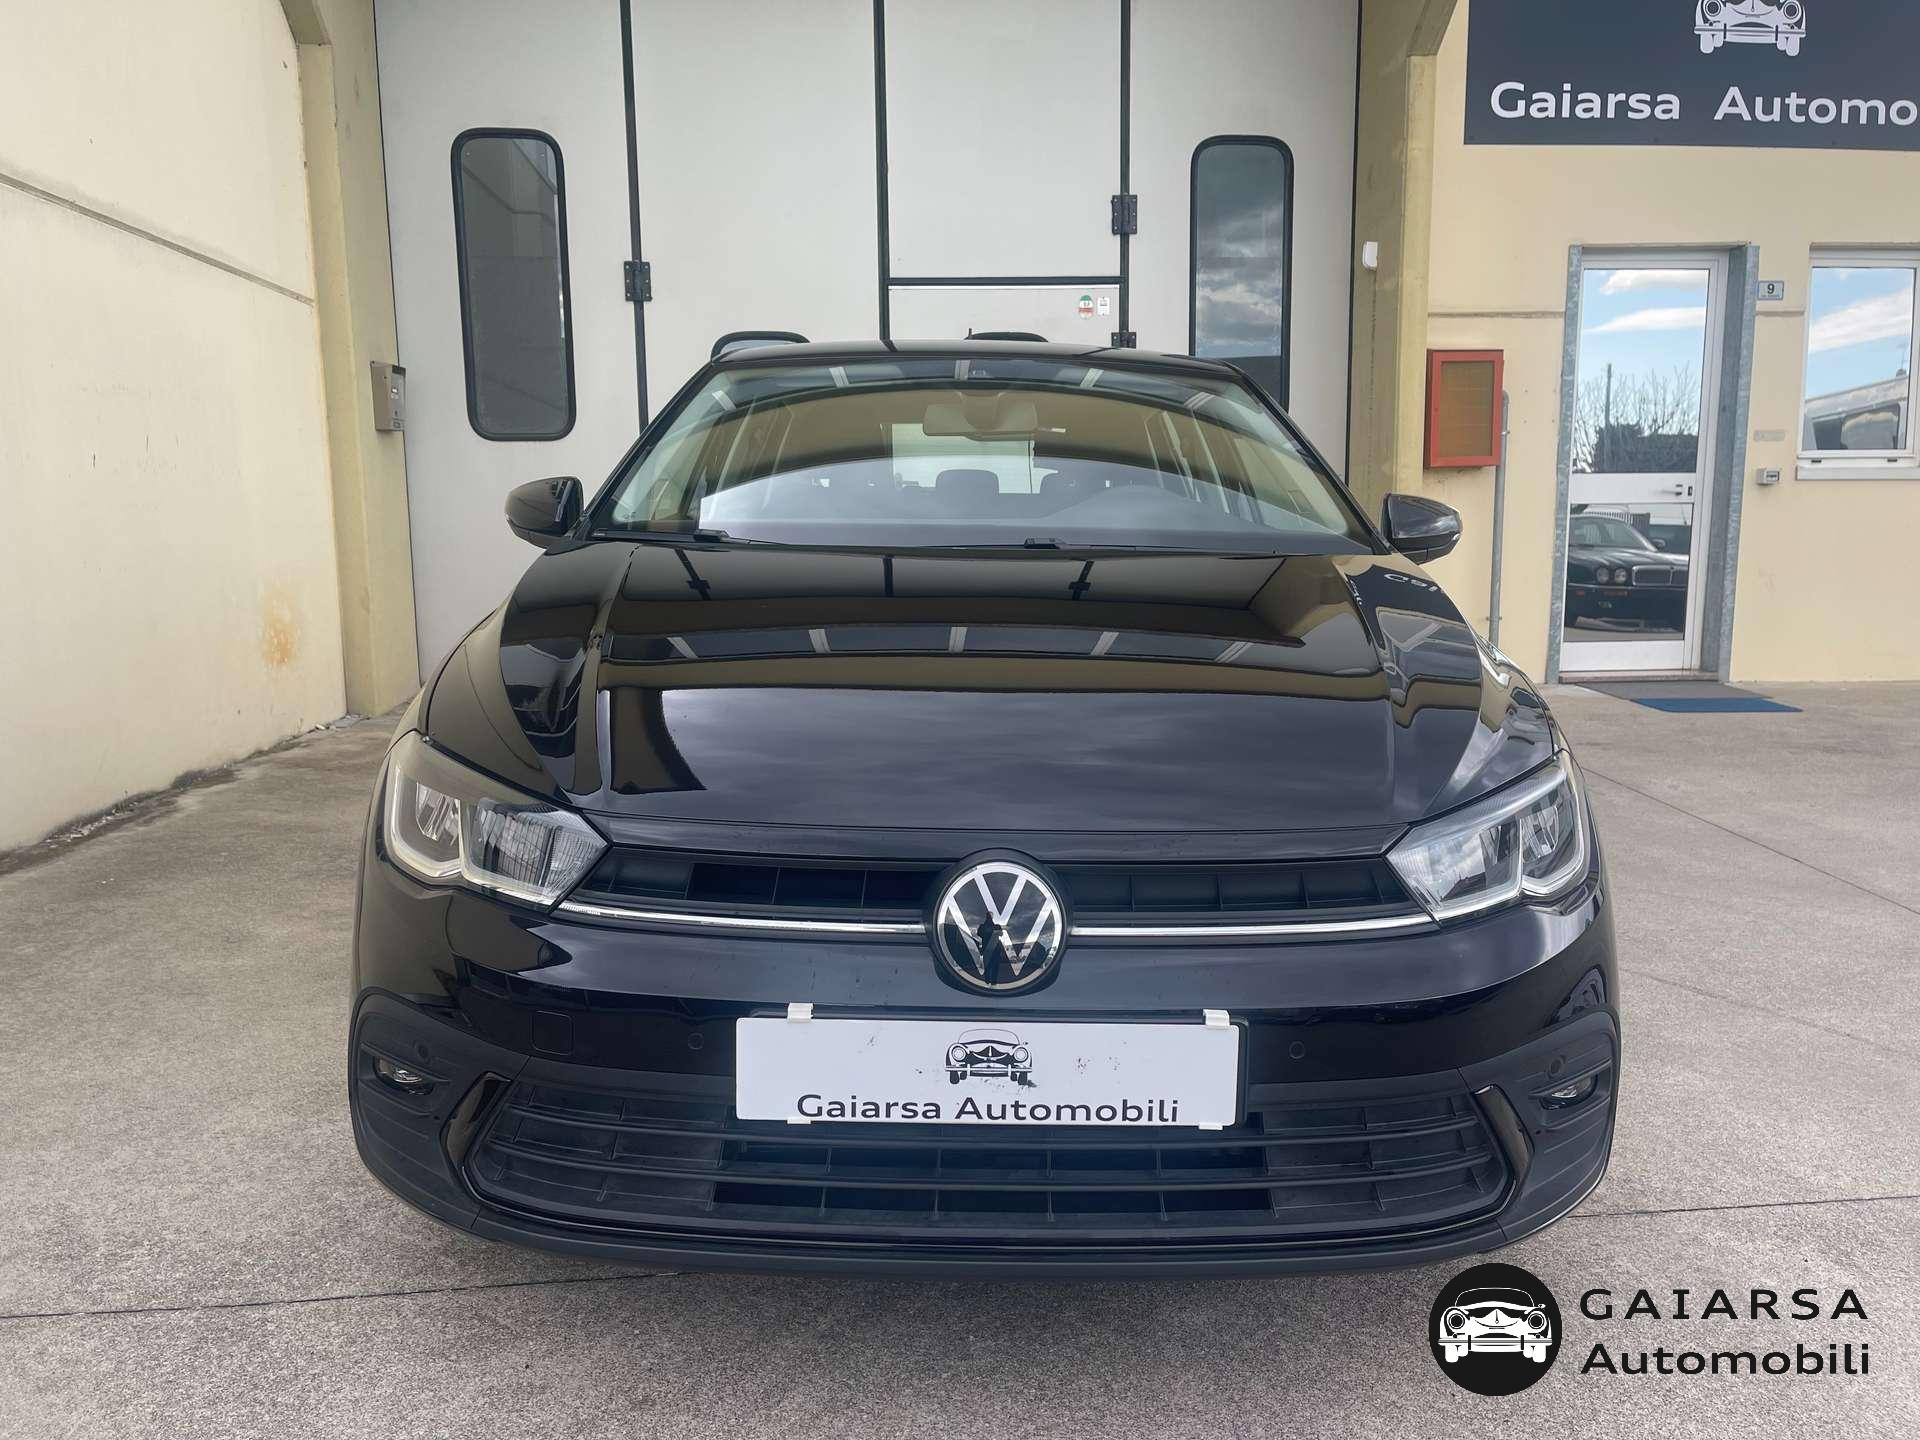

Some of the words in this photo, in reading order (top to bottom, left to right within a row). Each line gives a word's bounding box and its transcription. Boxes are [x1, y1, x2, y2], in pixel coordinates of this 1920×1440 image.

[1490, 81, 1680, 120] Gaiarsa
[1713, 86, 1918, 125] Automo
[1767, 283, 1775, 295] 9
[797, 1093, 942, 1119] Gaiarsa
[955, 1097, 1179, 1122] Automobili
